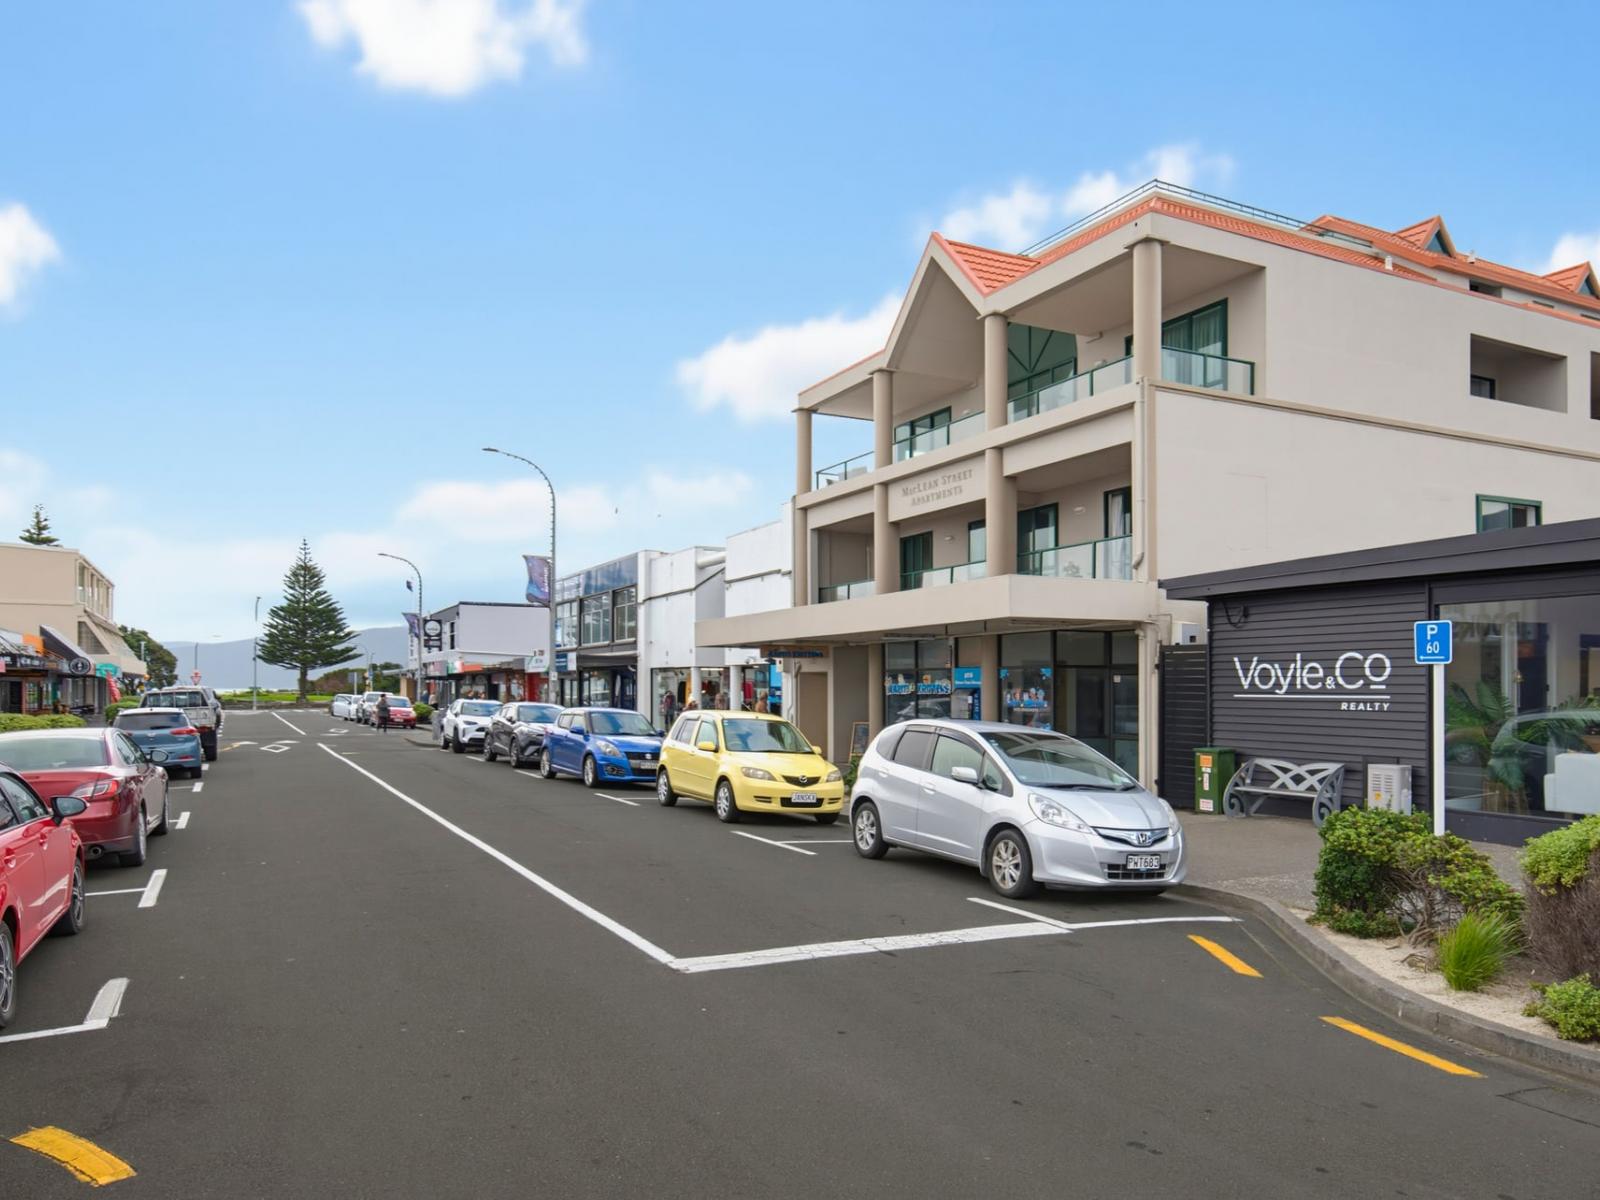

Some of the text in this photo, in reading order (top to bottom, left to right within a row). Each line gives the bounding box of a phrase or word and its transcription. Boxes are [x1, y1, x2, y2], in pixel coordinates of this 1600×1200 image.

[941, 469, 973, 485] STREET
[912, 485, 963, 506] APARTMENTS
[1426, 624, 1438, 641] P
[1426, 640, 1440, 654] 60
[1340, 702, 1391, 711] REALTY
